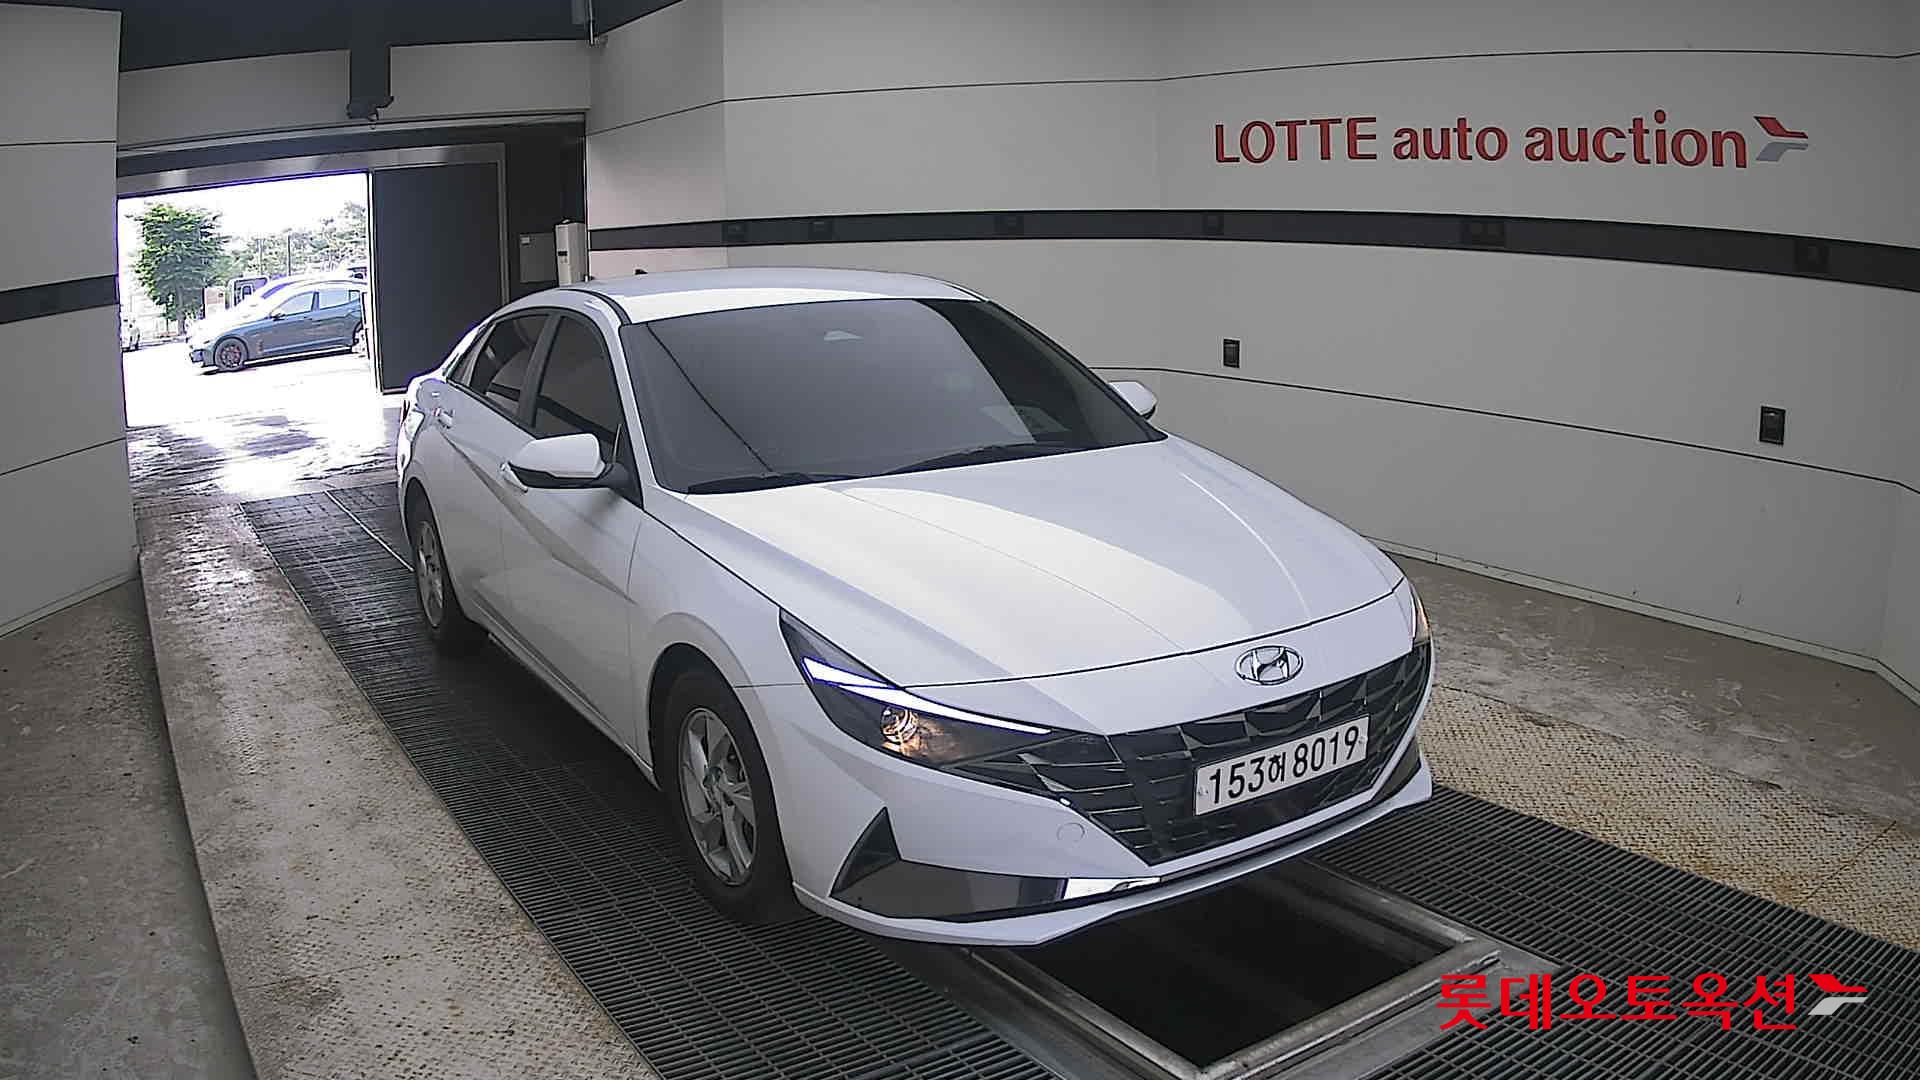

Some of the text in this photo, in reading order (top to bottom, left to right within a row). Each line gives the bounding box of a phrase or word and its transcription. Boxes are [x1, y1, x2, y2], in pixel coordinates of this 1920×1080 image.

[1215, 109, 1748, 168] LOTTE auto auction
